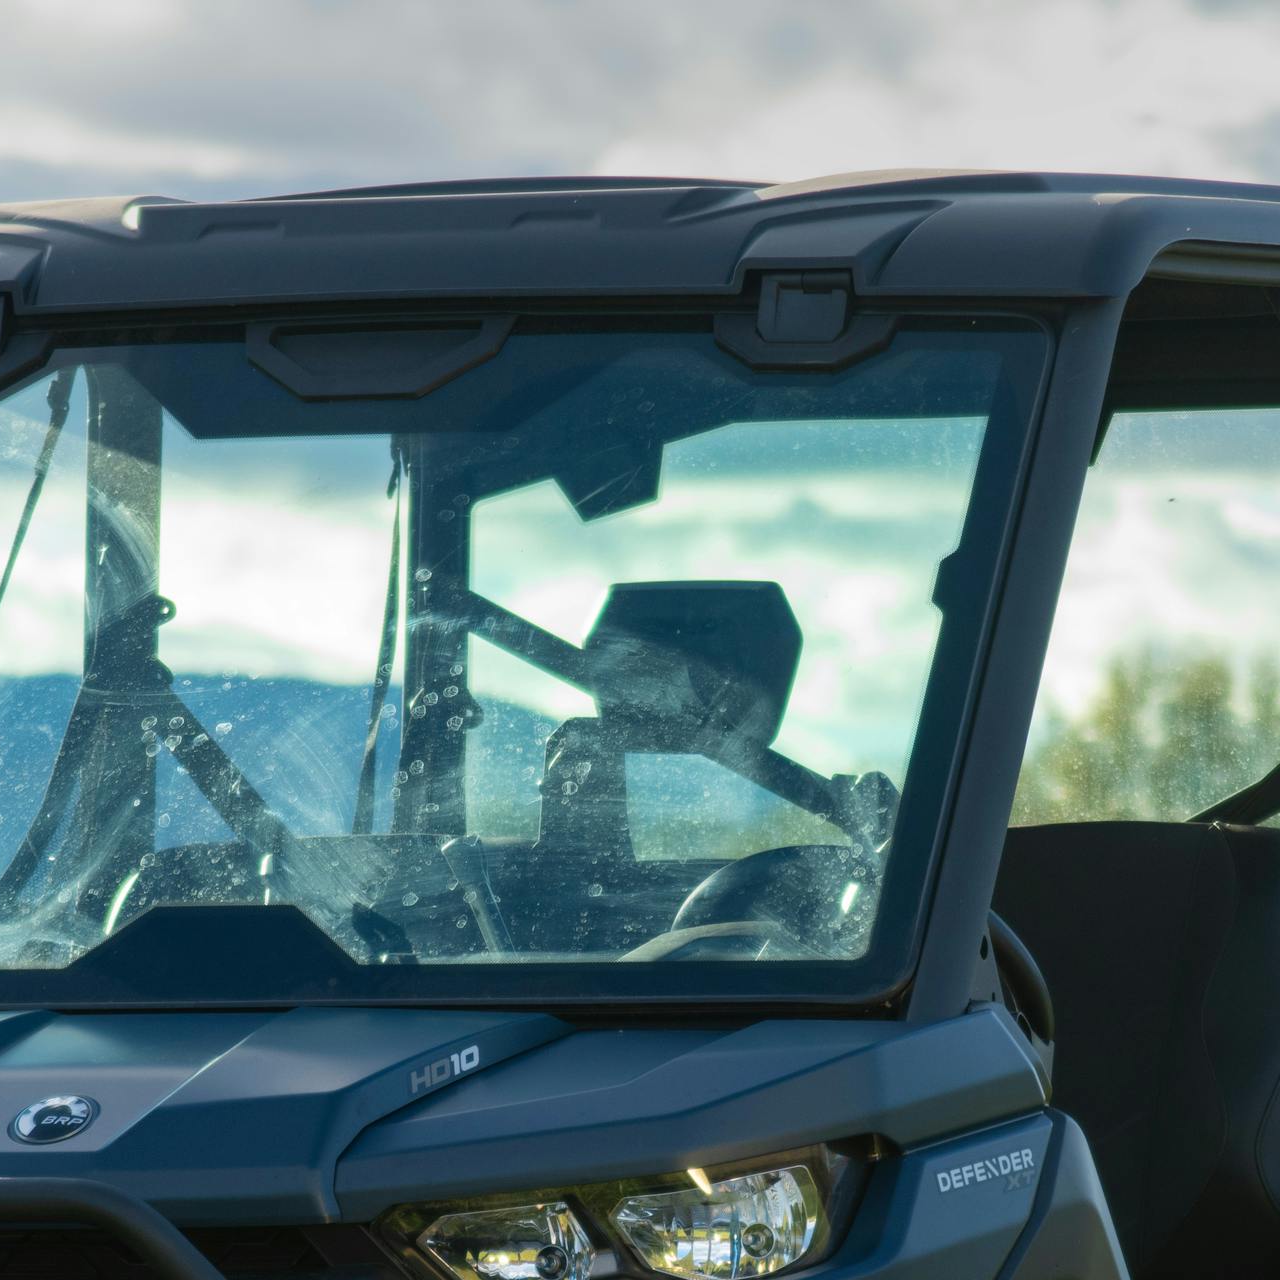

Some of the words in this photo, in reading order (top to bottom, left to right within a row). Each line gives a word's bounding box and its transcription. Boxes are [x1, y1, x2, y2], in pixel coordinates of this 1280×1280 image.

[410, 1045, 480, 1094] HD10
[41, 1115, 84, 1126] BRP
[936, 1148, 1034, 1193] DEFENDER
[1007, 1170, 1036, 1191] XT
